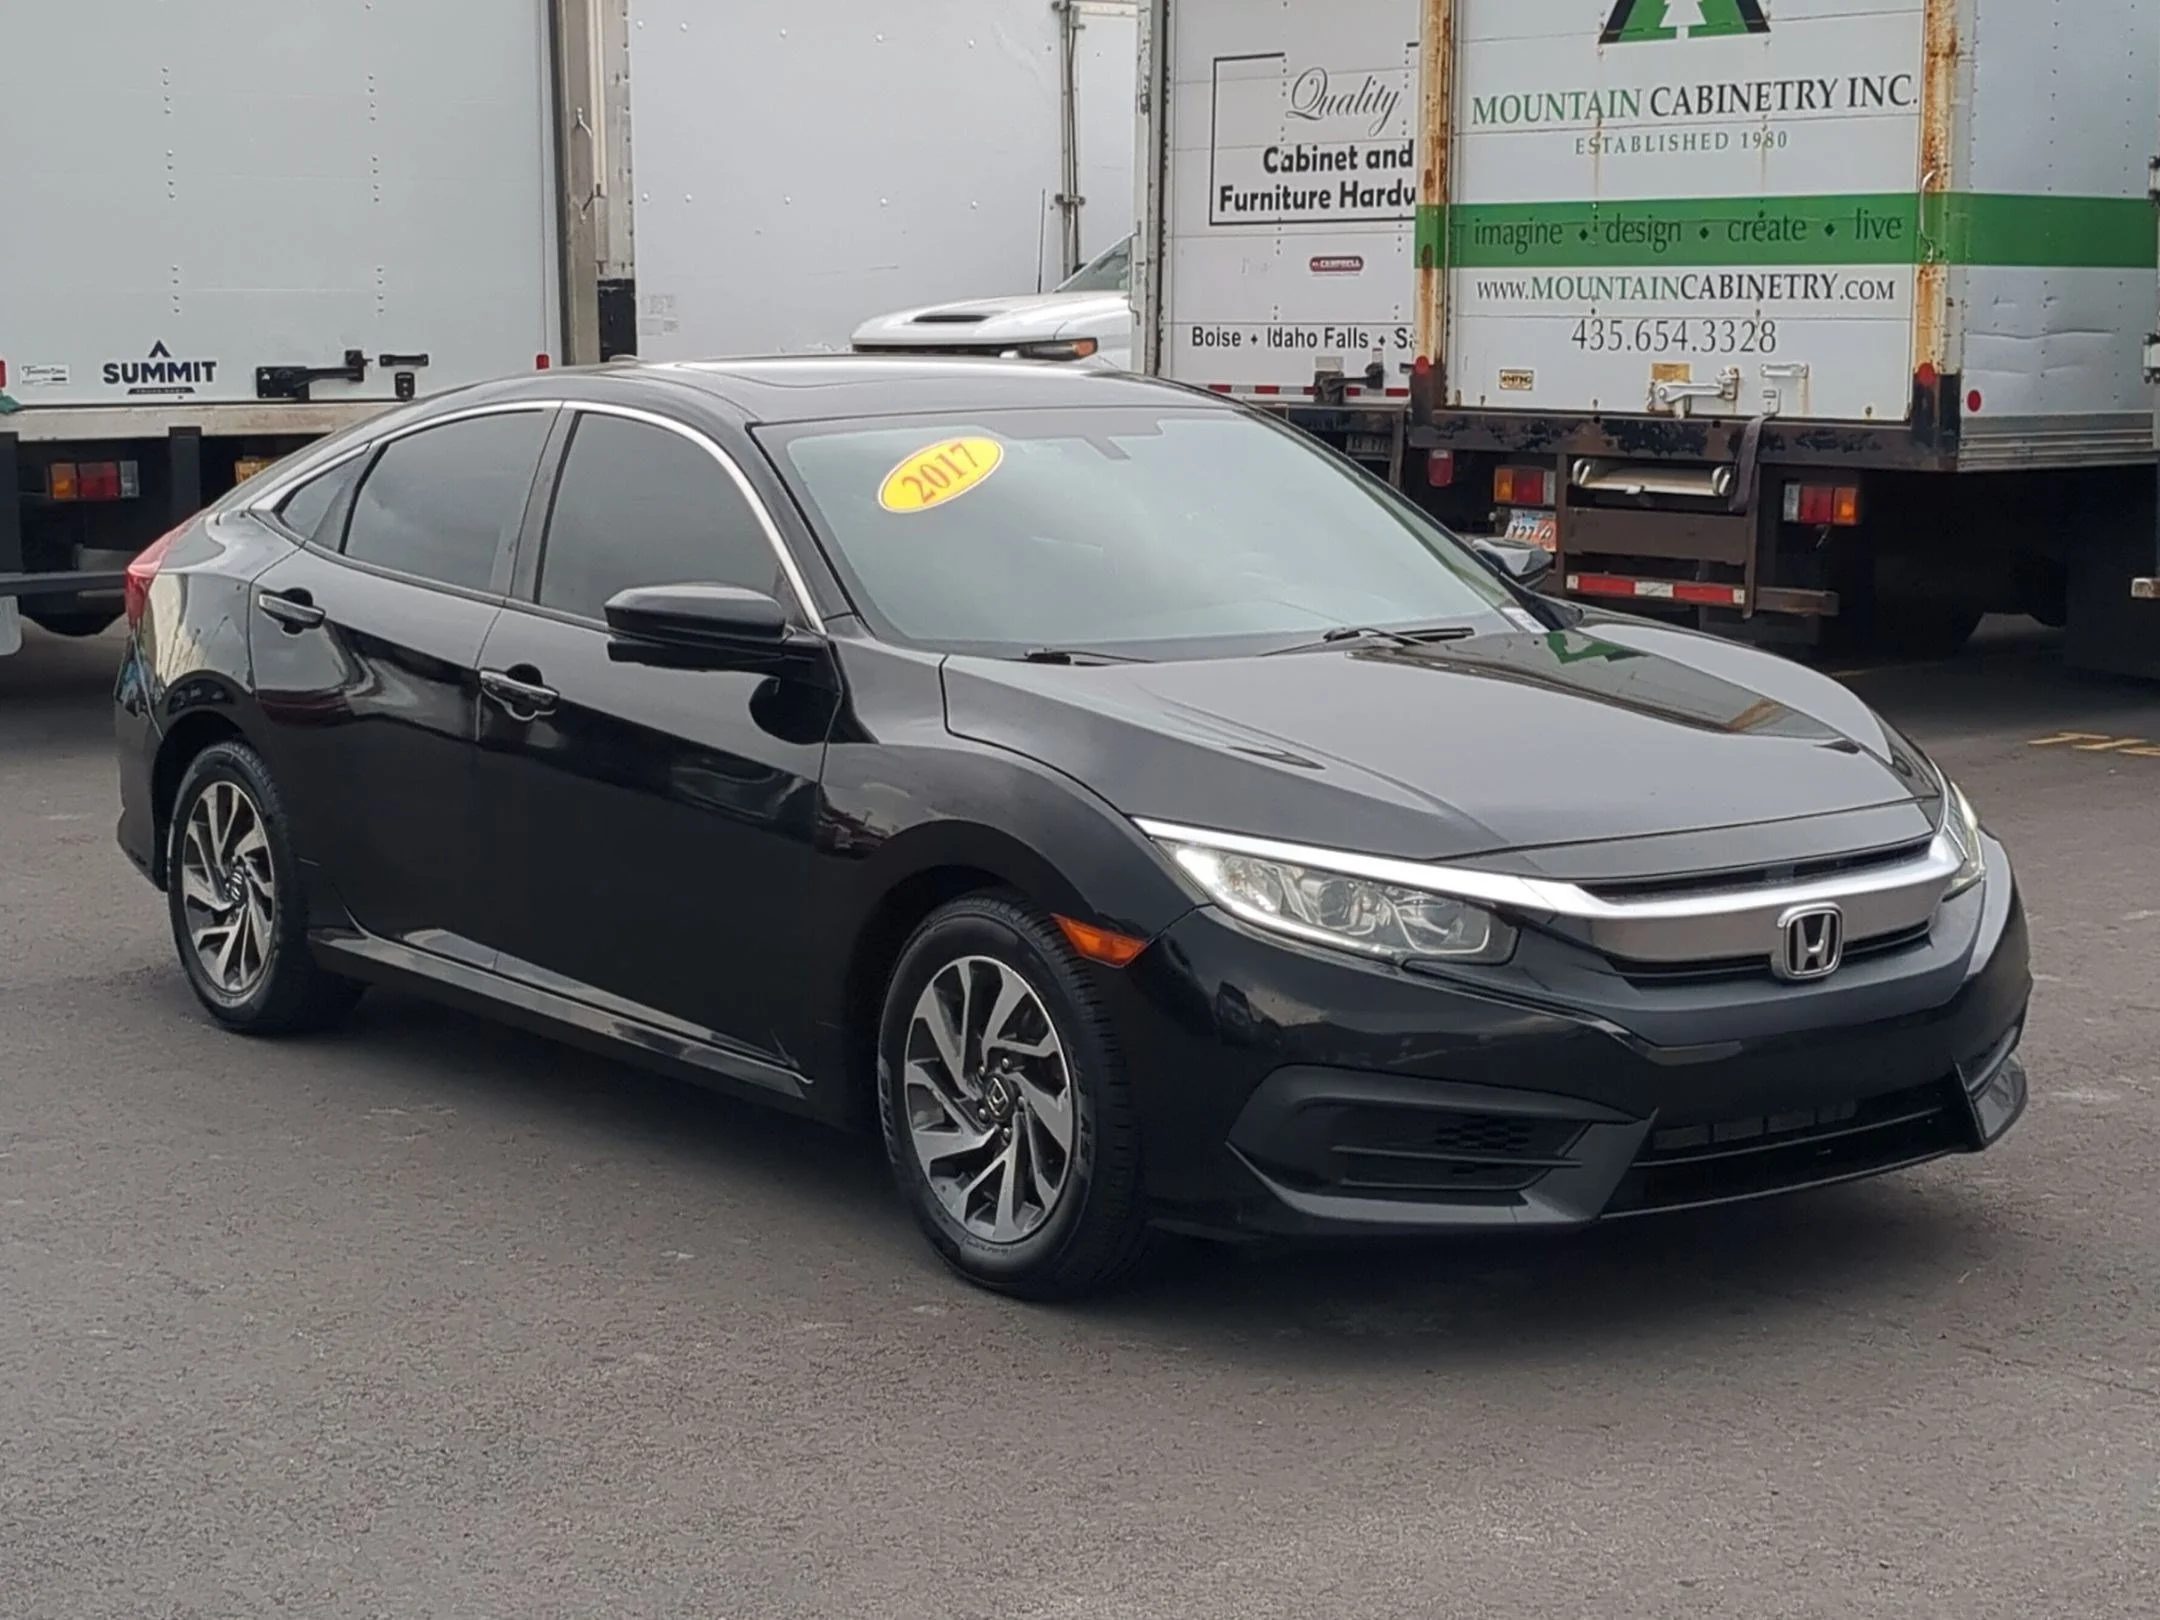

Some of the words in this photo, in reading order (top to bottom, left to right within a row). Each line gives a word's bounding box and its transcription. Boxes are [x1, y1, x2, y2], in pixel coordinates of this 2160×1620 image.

[1285, 67, 1399, 137] Quality
[1472, 88, 1642, 126] MOUNTAIN
[1650, 77, 1838, 117] CABINETRY
[1847, 74, 1918, 108] INC.
[1263, 145, 1358, 174] Cabinet
[1366, 139, 1414, 168] and
[1575, 132, 1729, 156] ESTABLISHED
[1741, 130, 1788, 150] 1980
[1219, 184, 1331, 213] Furniture
[1474, 216, 1563, 255] imagine
[1605, 213, 1682, 252] design
[1727, 214, 1807, 243] create
[1855, 208, 1902, 240] live
[1192, 326, 1241, 348] Boise
[1267, 326, 1317, 348] Idaho
[1324, 327, 1368, 349] Falls
[1571, 319, 1777, 353] 435.654.3328
[103, 361, 217, 385] SUMMIT
[901, 443, 978, 503] 2017
